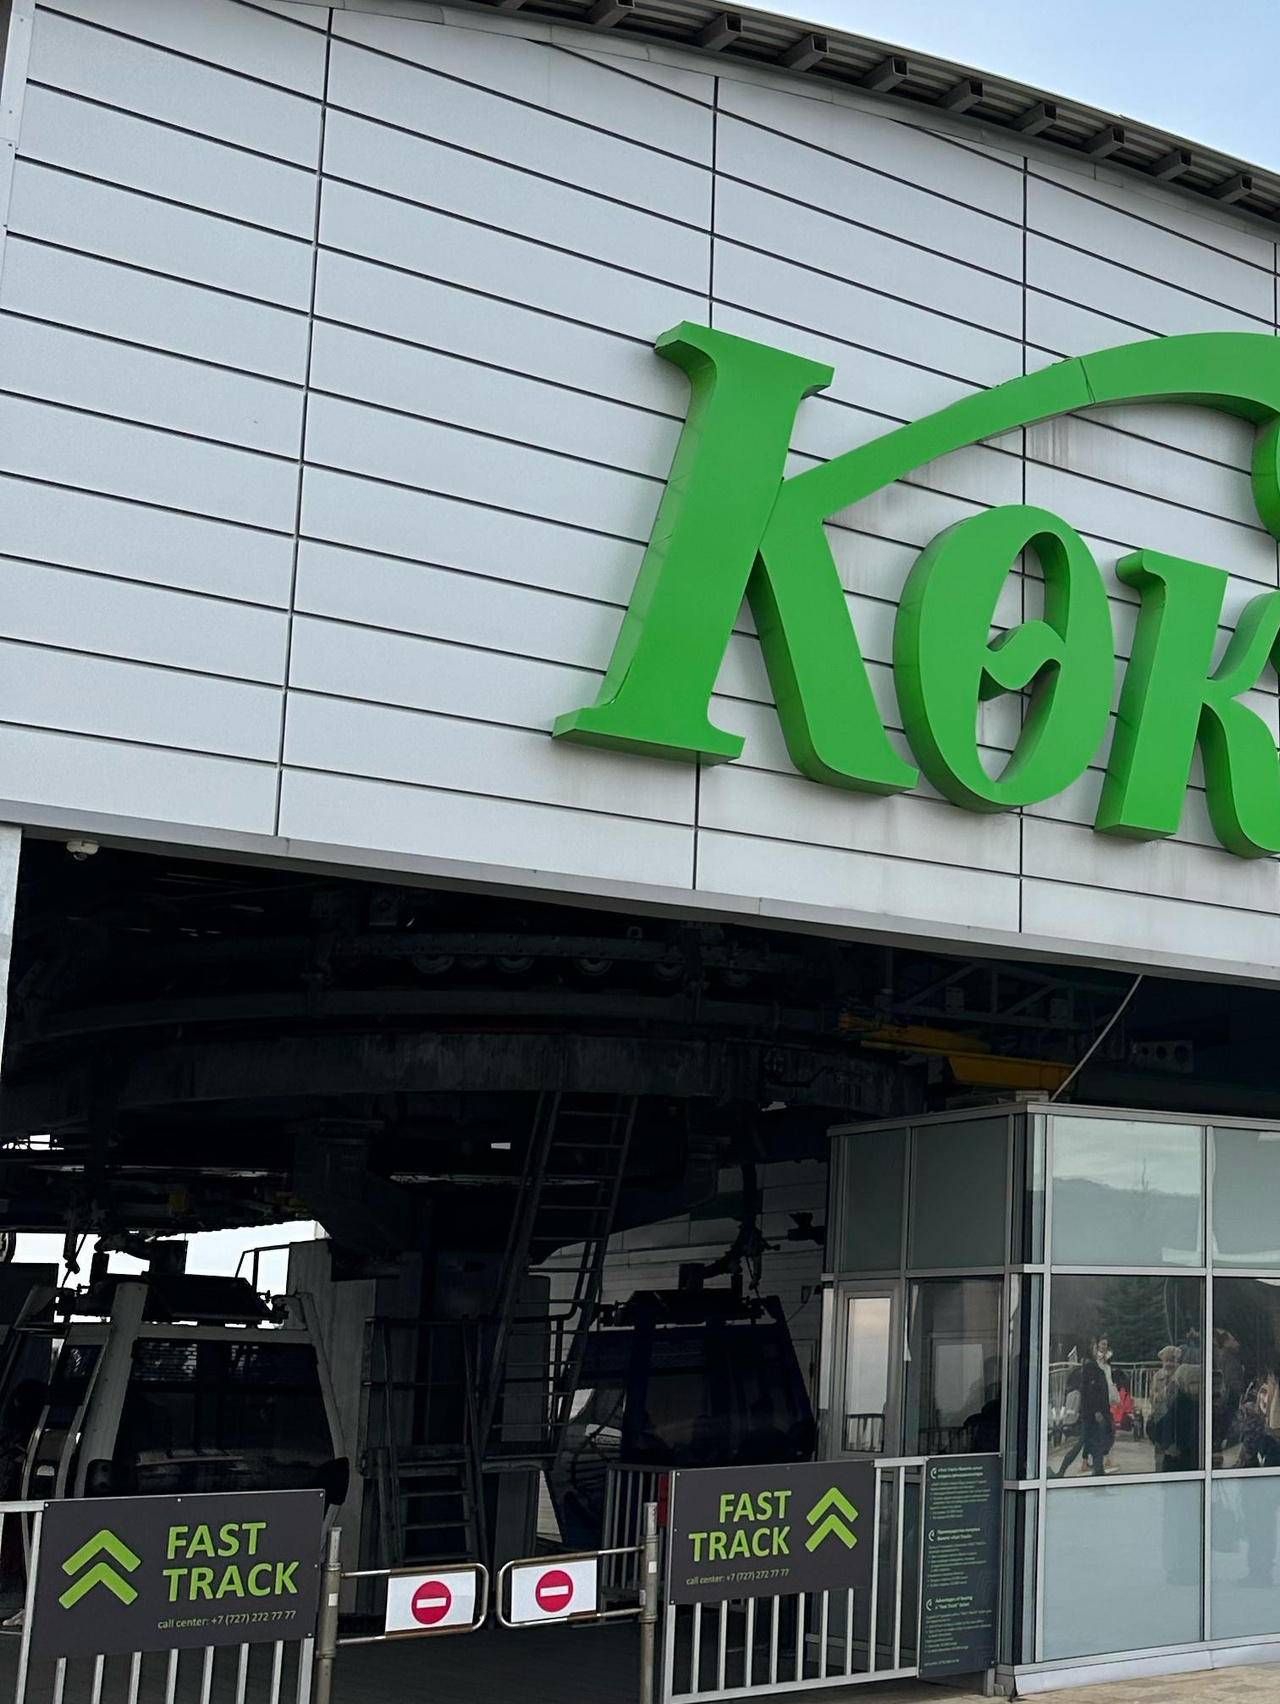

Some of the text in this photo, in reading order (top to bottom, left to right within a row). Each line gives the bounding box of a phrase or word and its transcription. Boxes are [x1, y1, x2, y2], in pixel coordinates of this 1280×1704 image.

[719, 1490, 791, 1523] FAST
[166, 1522, 267, 1560] FAST
[689, 1526, 790, 1562] TRACK
[163, 1561, 299, 1602] TRACK
[686, 1568, 790, 1586] call center: +7 (727) 272 77 77
[158, 1610, 297, 1629] call center: +7 (727) 272 77 77
